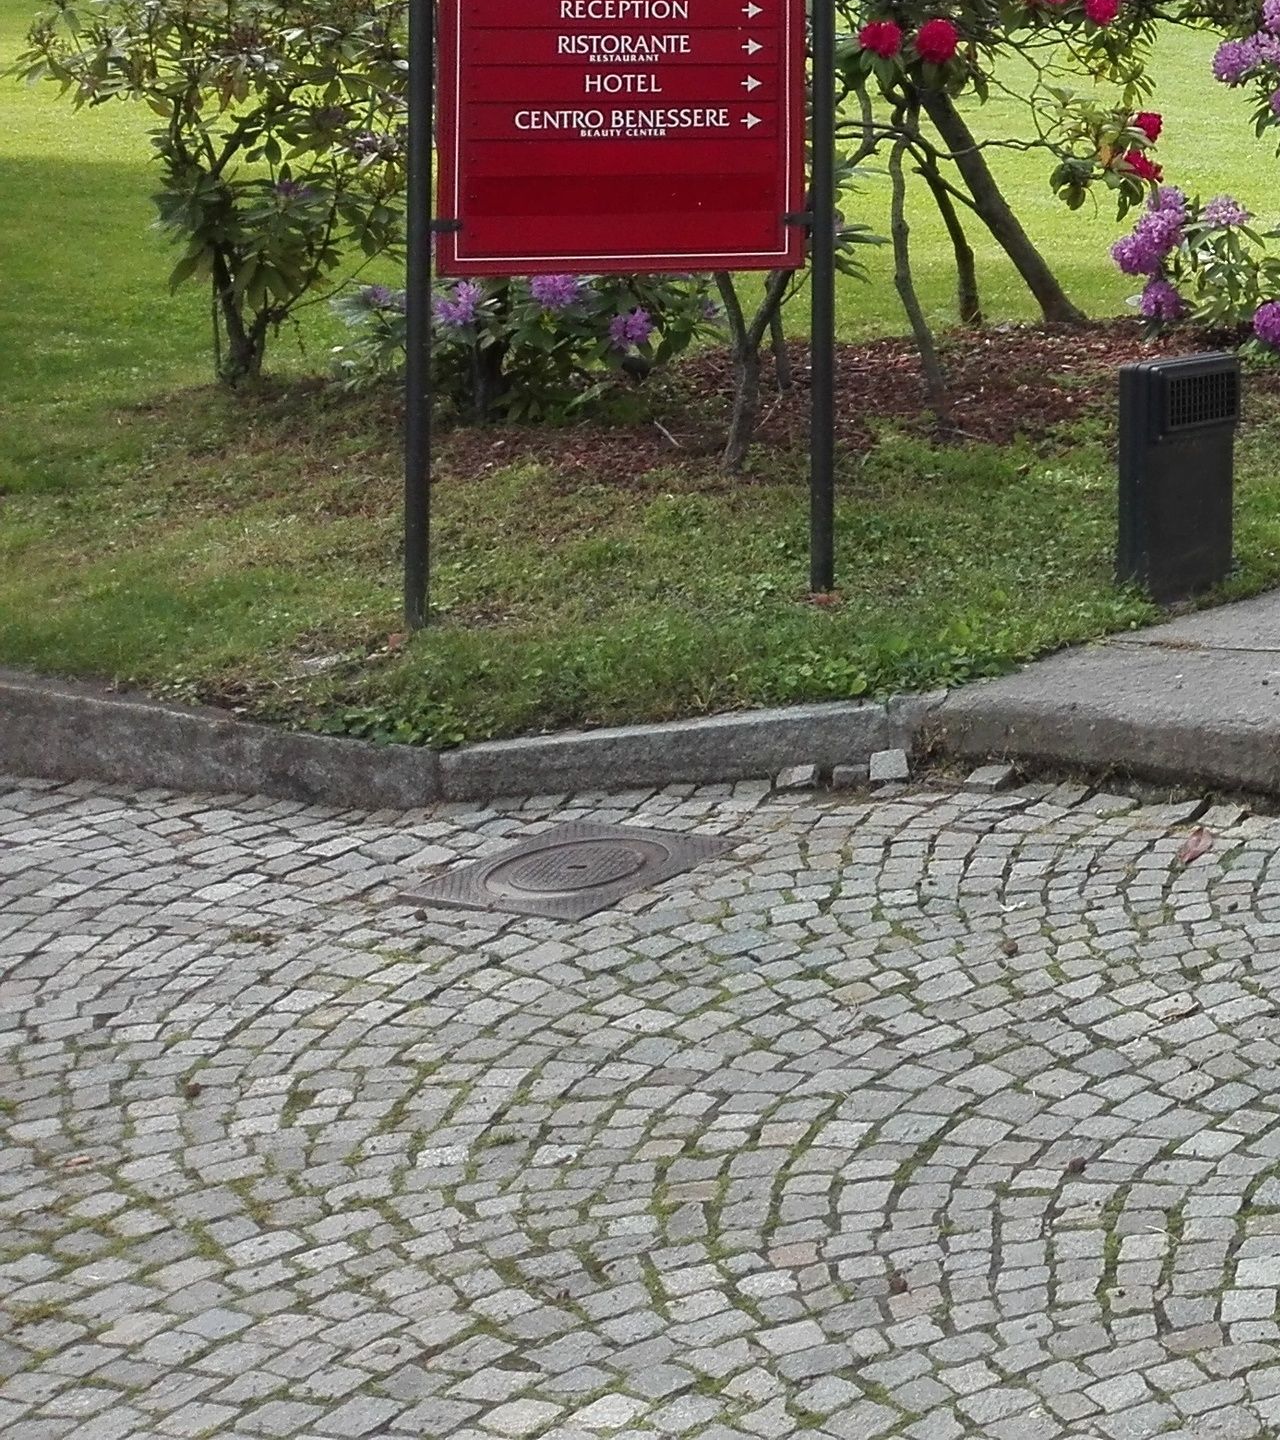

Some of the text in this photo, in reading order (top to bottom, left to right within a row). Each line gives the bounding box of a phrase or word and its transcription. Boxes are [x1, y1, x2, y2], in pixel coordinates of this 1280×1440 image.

[559, 0, 689, 19] RECEPTION
[557, 35, 691, 54] RISTORANTE
[589, 54, 659, 62] RESTAURANT
[584, 74, 662, 93] HOTEL
[514, 108, 730, 129] CENTRO BENESSERE
[580, 128, 666, 137] BEAUTY CENTER
